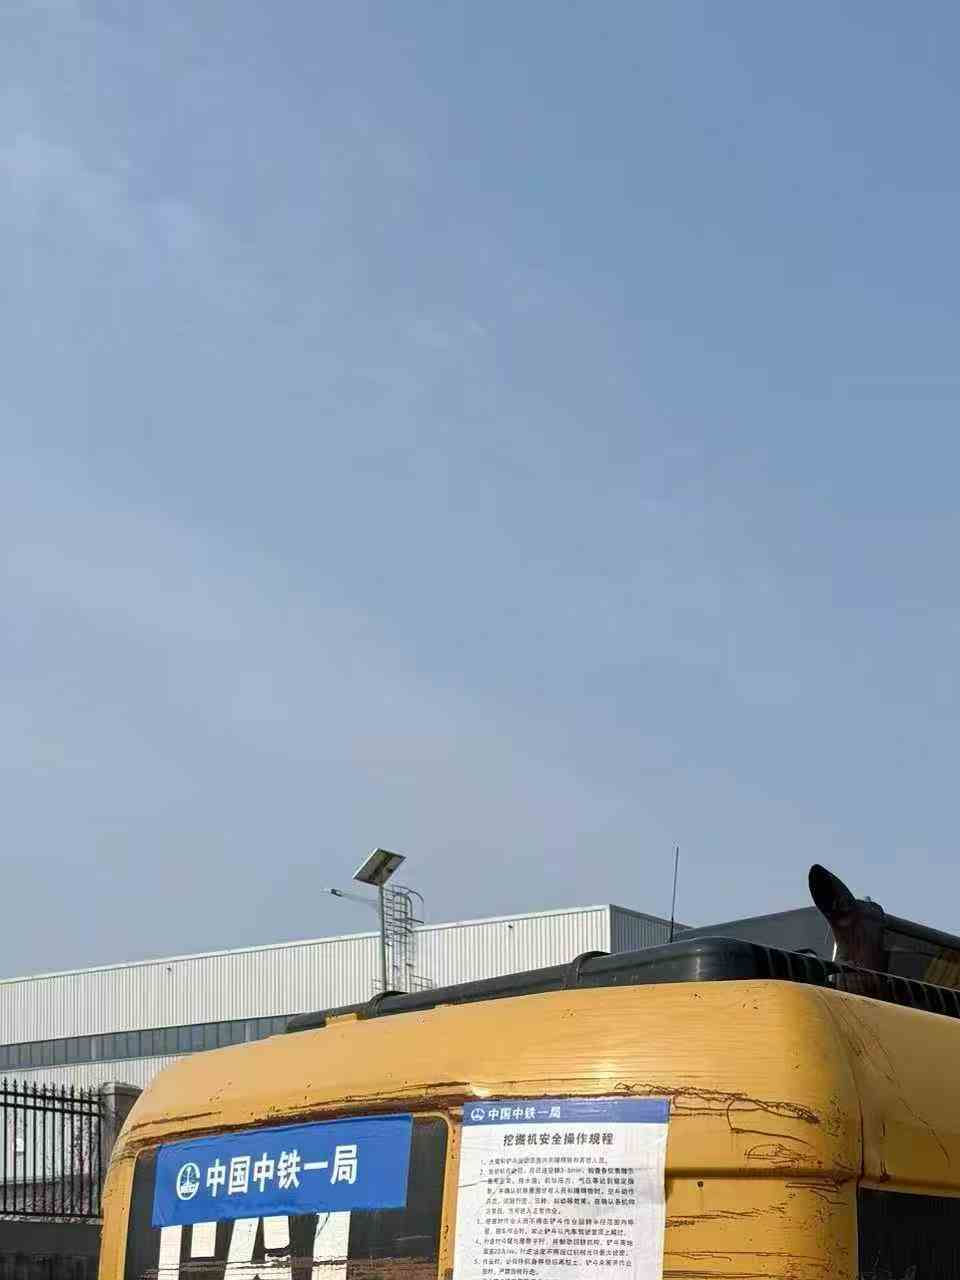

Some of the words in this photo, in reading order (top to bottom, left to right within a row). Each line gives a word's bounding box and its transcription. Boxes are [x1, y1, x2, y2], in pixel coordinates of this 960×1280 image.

[487, 1106, 561, 1121] 中国中铁一局
[502, 1132, 615, 1147] 挖掘机安全操作规程
[206, 1144, 359, 1197] 中国中铁一局
